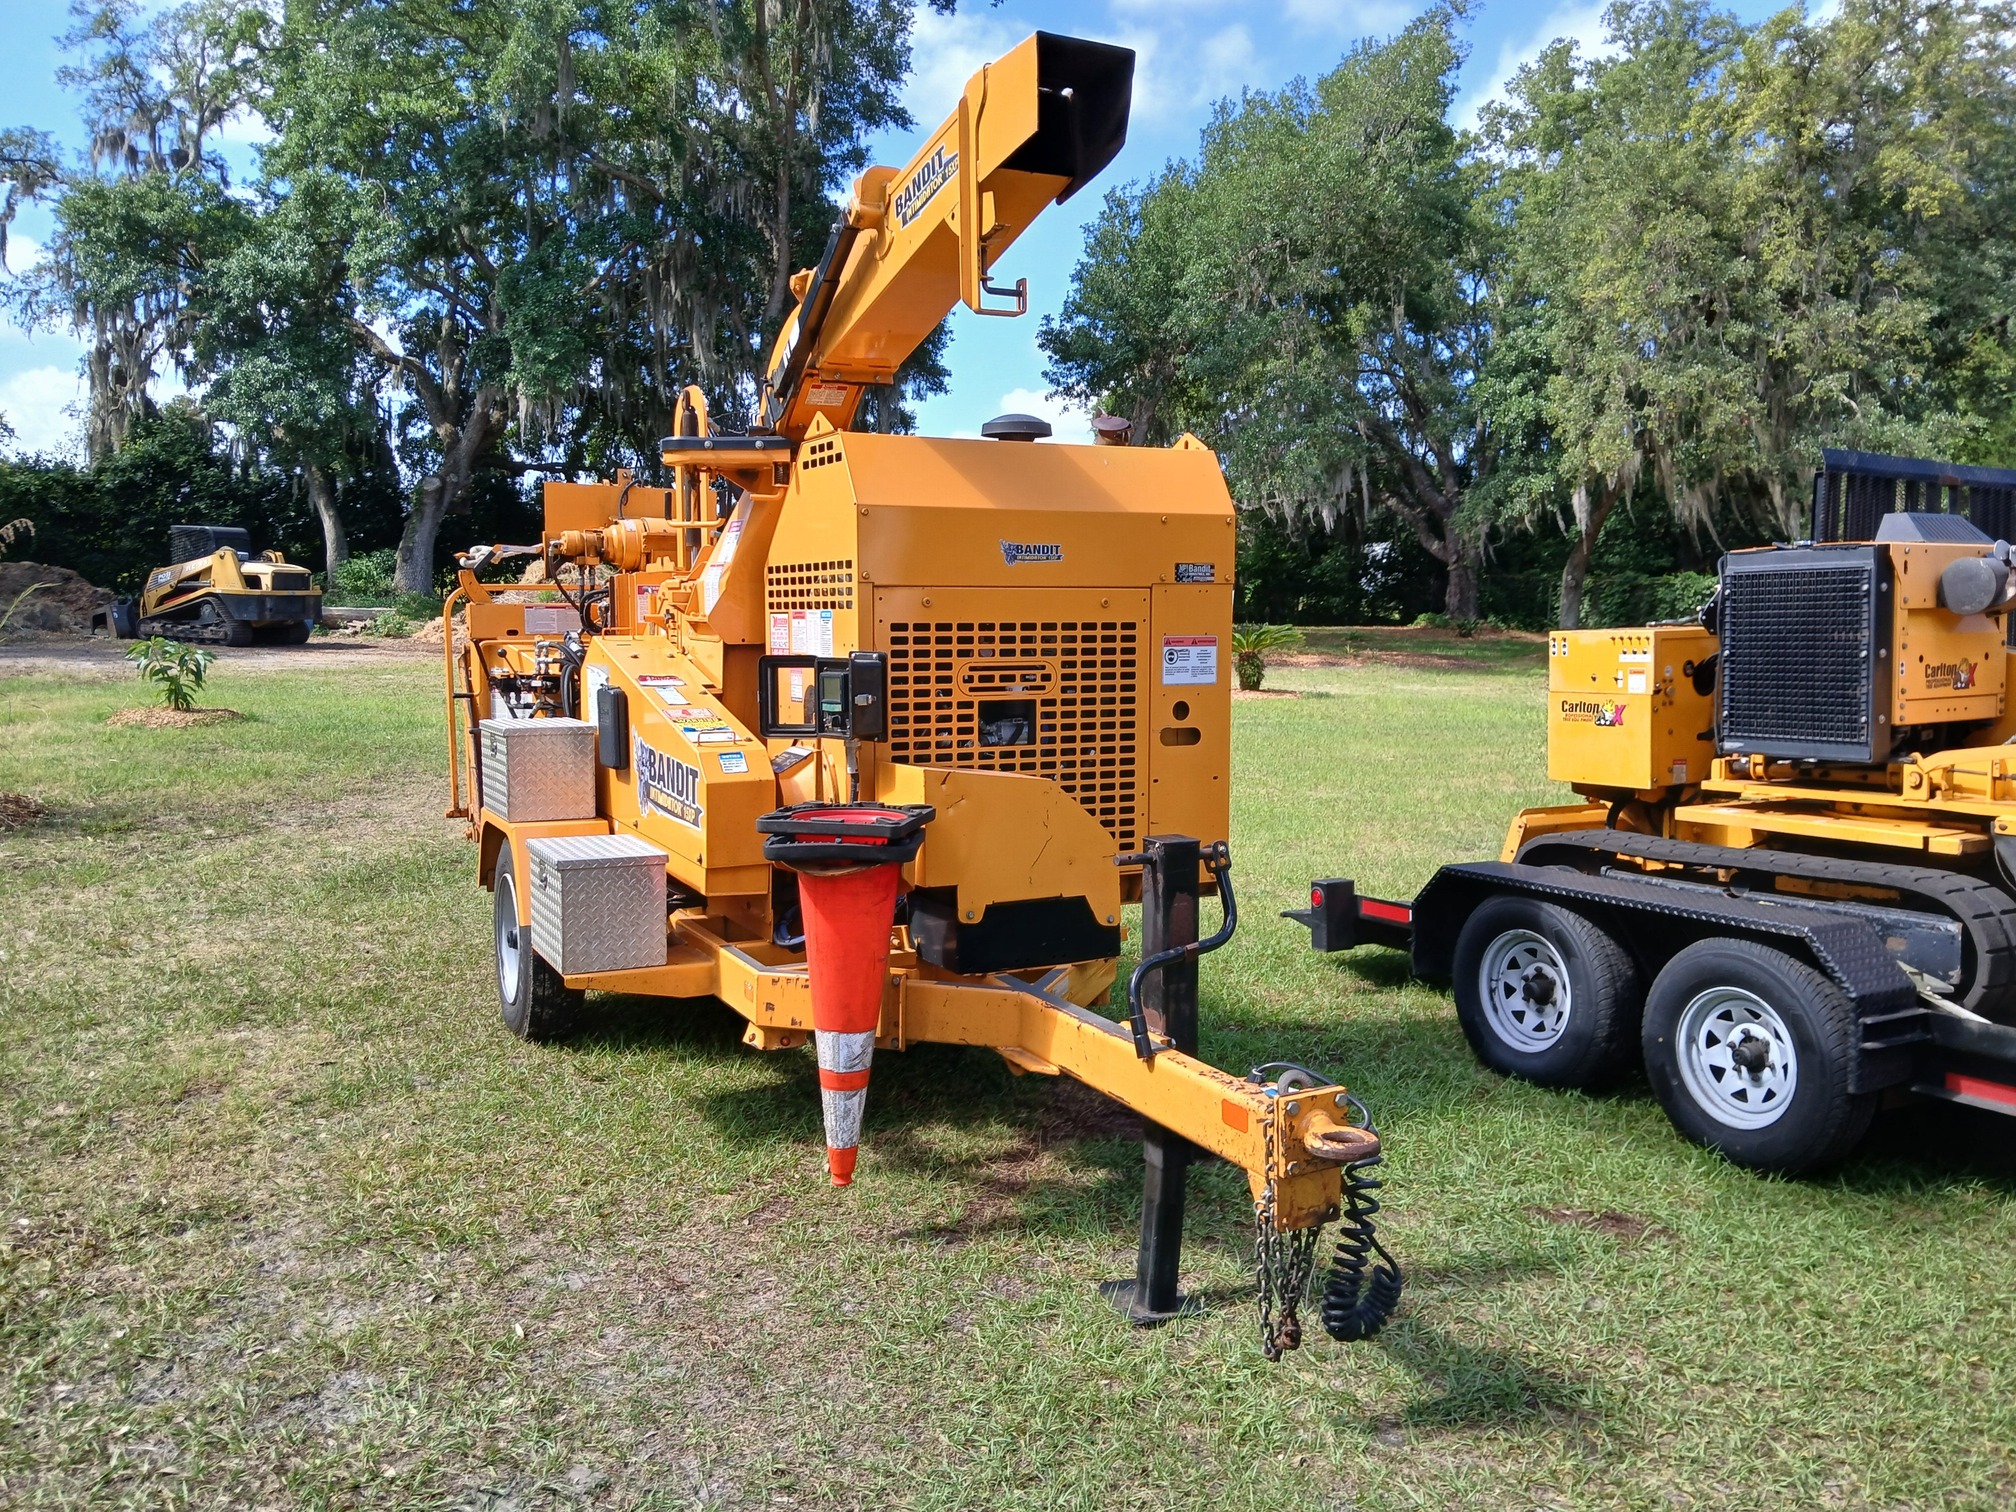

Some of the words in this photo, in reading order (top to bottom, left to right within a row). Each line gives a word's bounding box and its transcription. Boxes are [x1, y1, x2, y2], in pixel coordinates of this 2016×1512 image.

[895, 145, 944, 218] BANDIT
[1016, 545, 1060, 555] BANDIT
[1188, 564, 1211, 573] Bandit
[1925, 662, 1958, 679] Carlton
[1561, 700, 1601, 715] Carlton
[647, 747, 699, 806] BANDIT
